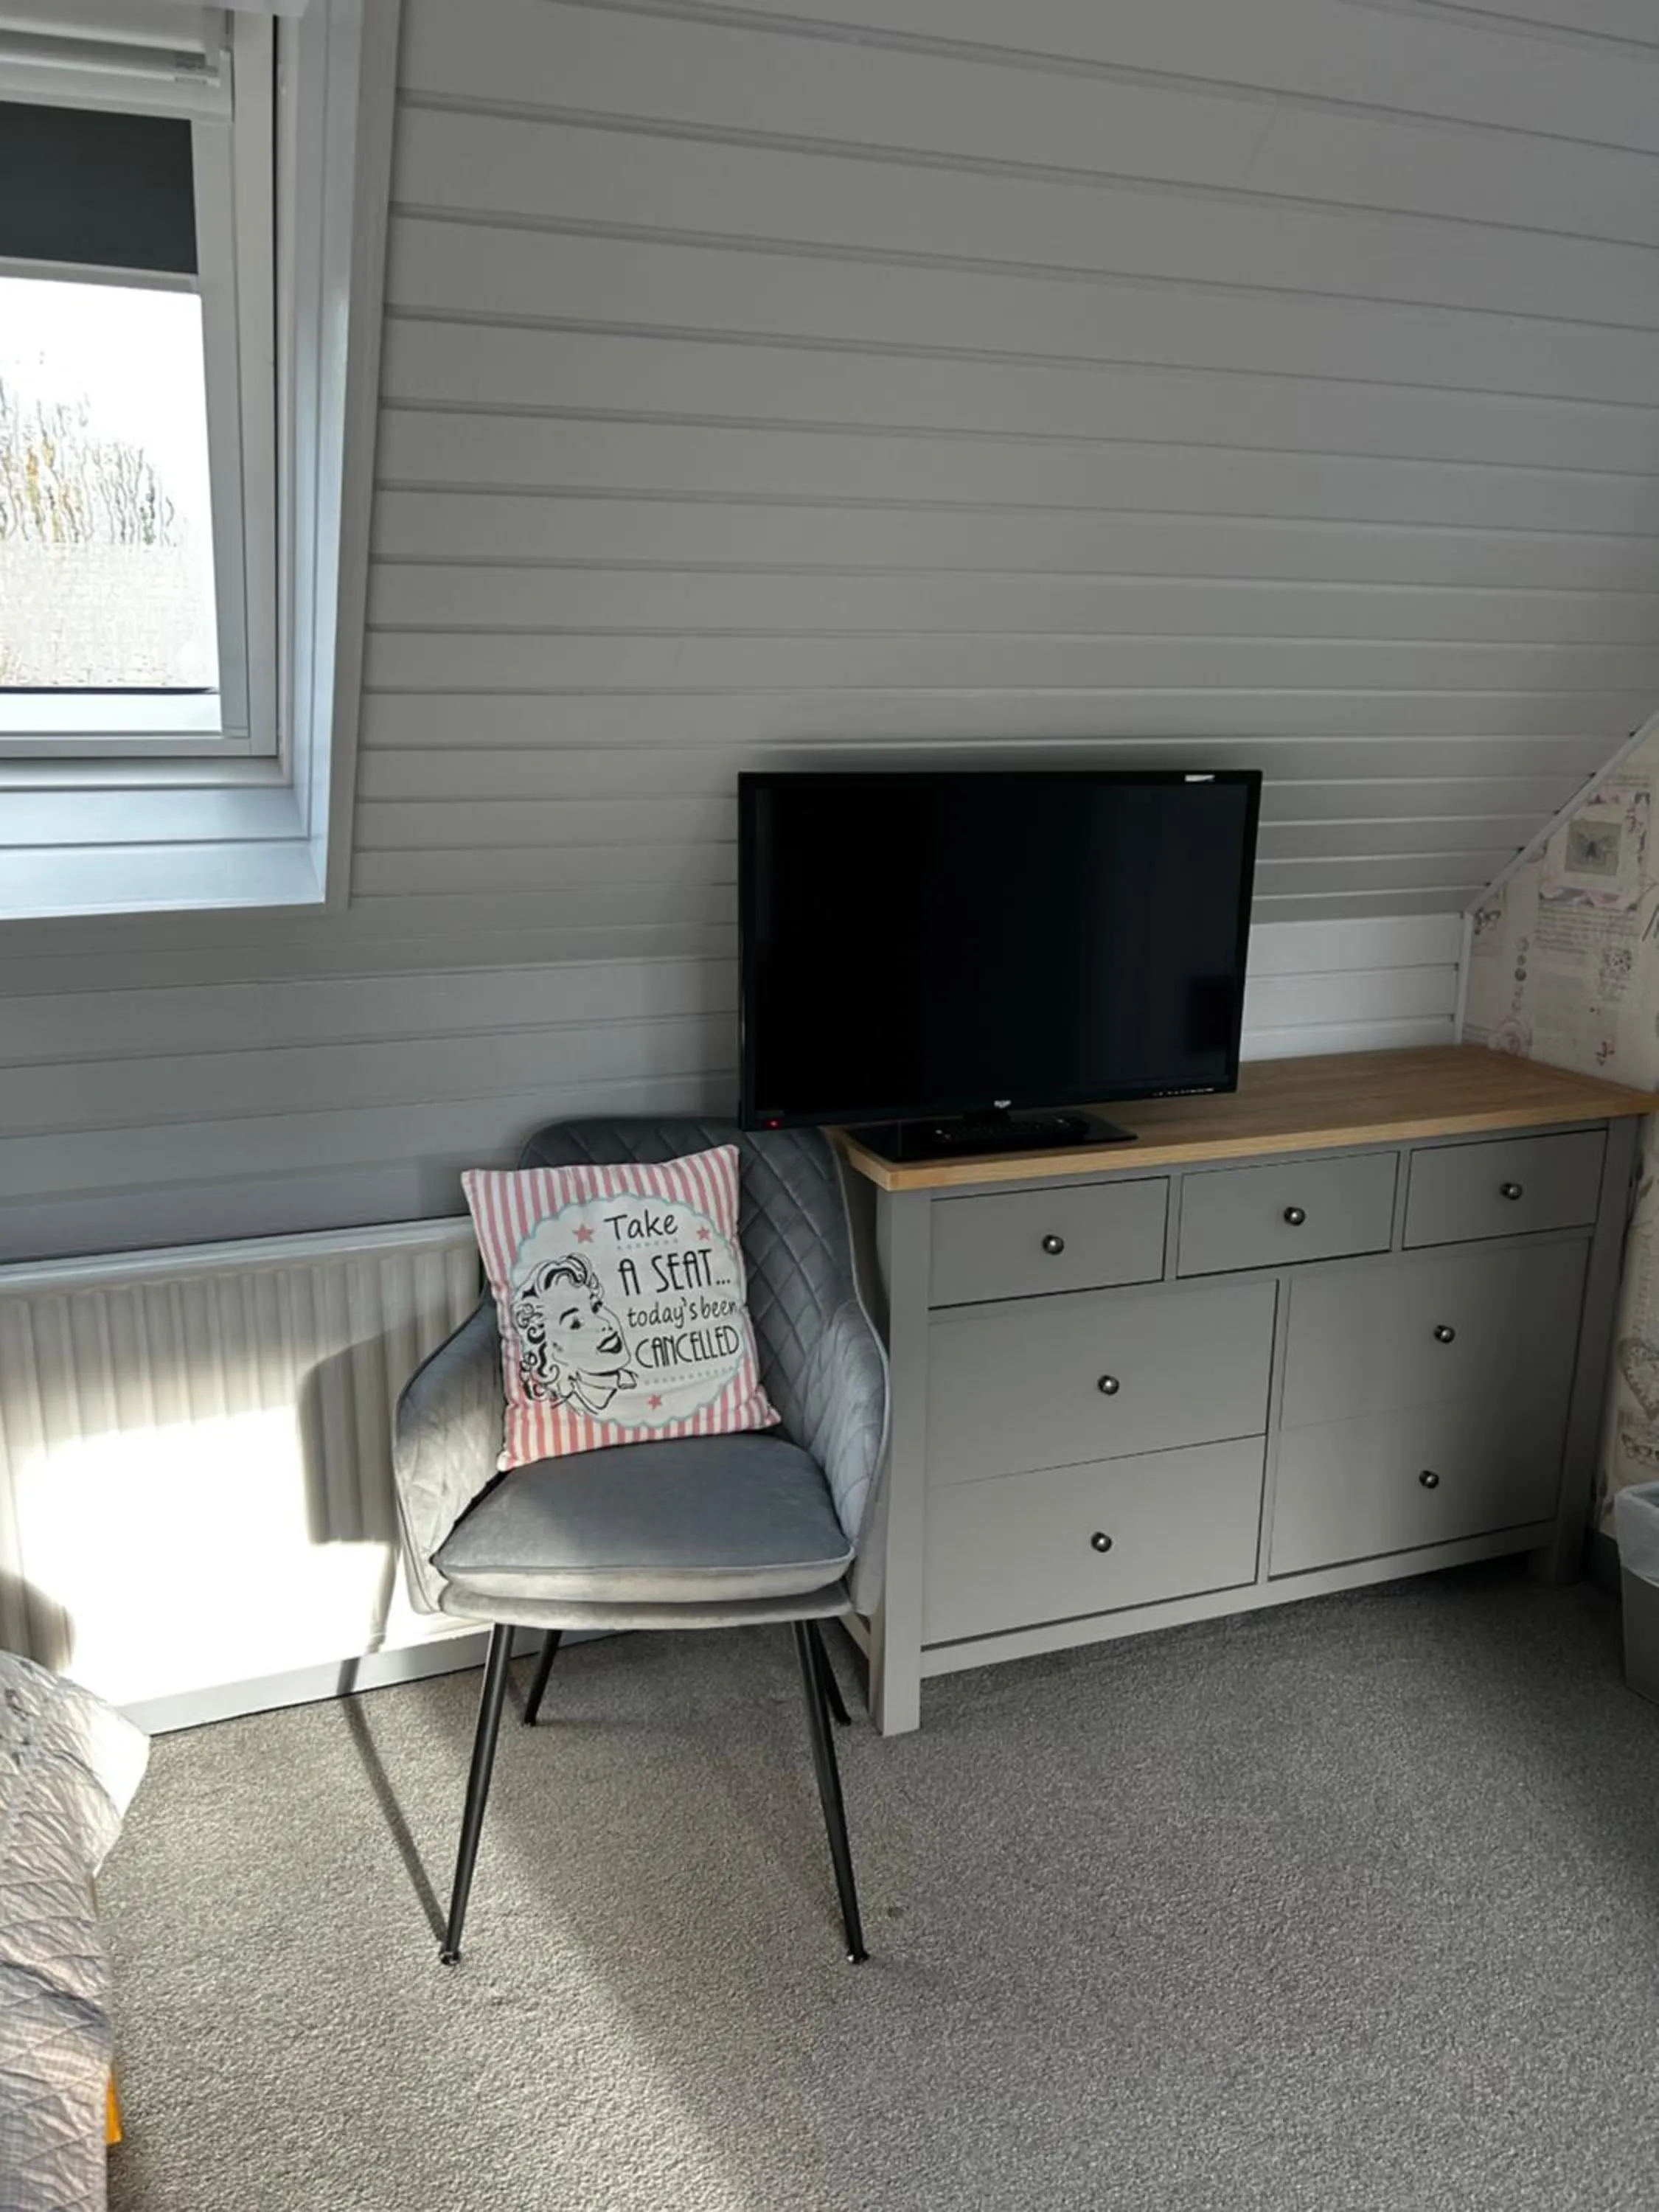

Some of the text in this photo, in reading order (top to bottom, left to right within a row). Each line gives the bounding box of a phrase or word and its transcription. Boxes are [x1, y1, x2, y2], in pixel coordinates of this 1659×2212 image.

[604, 1210, 678, 1240] Take
[618, 1248, 731, 1296] A SEAT...
[627, 1296, 698, 1329] today's
[635, 1325, 740, 1369] CANCELLED
